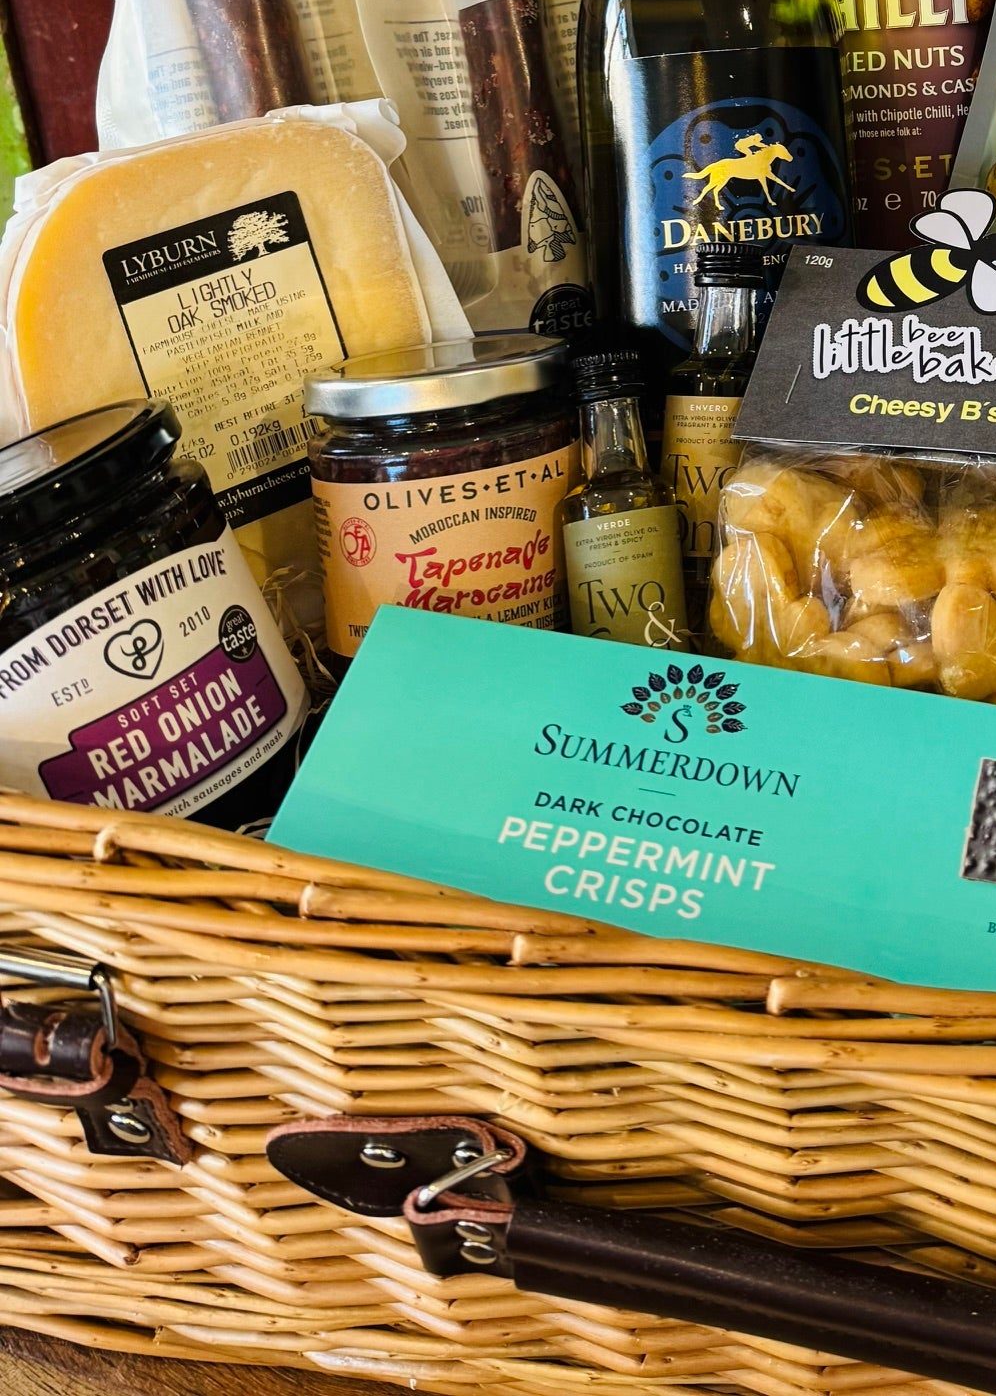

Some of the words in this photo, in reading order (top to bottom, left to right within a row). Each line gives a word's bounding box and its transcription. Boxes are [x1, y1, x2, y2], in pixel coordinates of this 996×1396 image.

[894, 46, 965, 70] NUTS
[857, 112, 878, 122] with
[881, 107, 922, 123] Chipotle
[925, 105, 954, 119] Chilli,
[662, 212, 826, 251] DANEBURY
[122, 231, 217, 279] LYBURN
[805, 254, 834, 268] 120g
[168, 311, 203, 334] OAK
[213, 282, 276, 320] SMOKED
[177, 268, 253, 310] LIGHTLY
[818, 322, 912, 374] little
[908, 319, 965, 343] bee
[850, 394, 955, 423] Cheesy
[231, 419, 281, 446] 0.192kg
[409, 509, 481, 545] MOROCCAN
[484, 505, 537, 523] INSPIRED
[576, 538, 595, 547] EXTRA
[596, 533, 622, 543] VIRGIN
[624, 529, 646, 538] OLIVE
[597, 519, 631, 531] VERDE
[395, 529, 551, 589] Tapenade
[87, 734, 152, 780] RED
[157, 669, 243, 740] ONION
[533, 724, 801, 798] SUMMERDOWN
[534, 791, 605, 818] DARK
[611, 805, 765, 847] CHOCOLATE
[497, 816, 776, 891] PEPPERMINT
[544, 865, 705, 919] CRISPS
